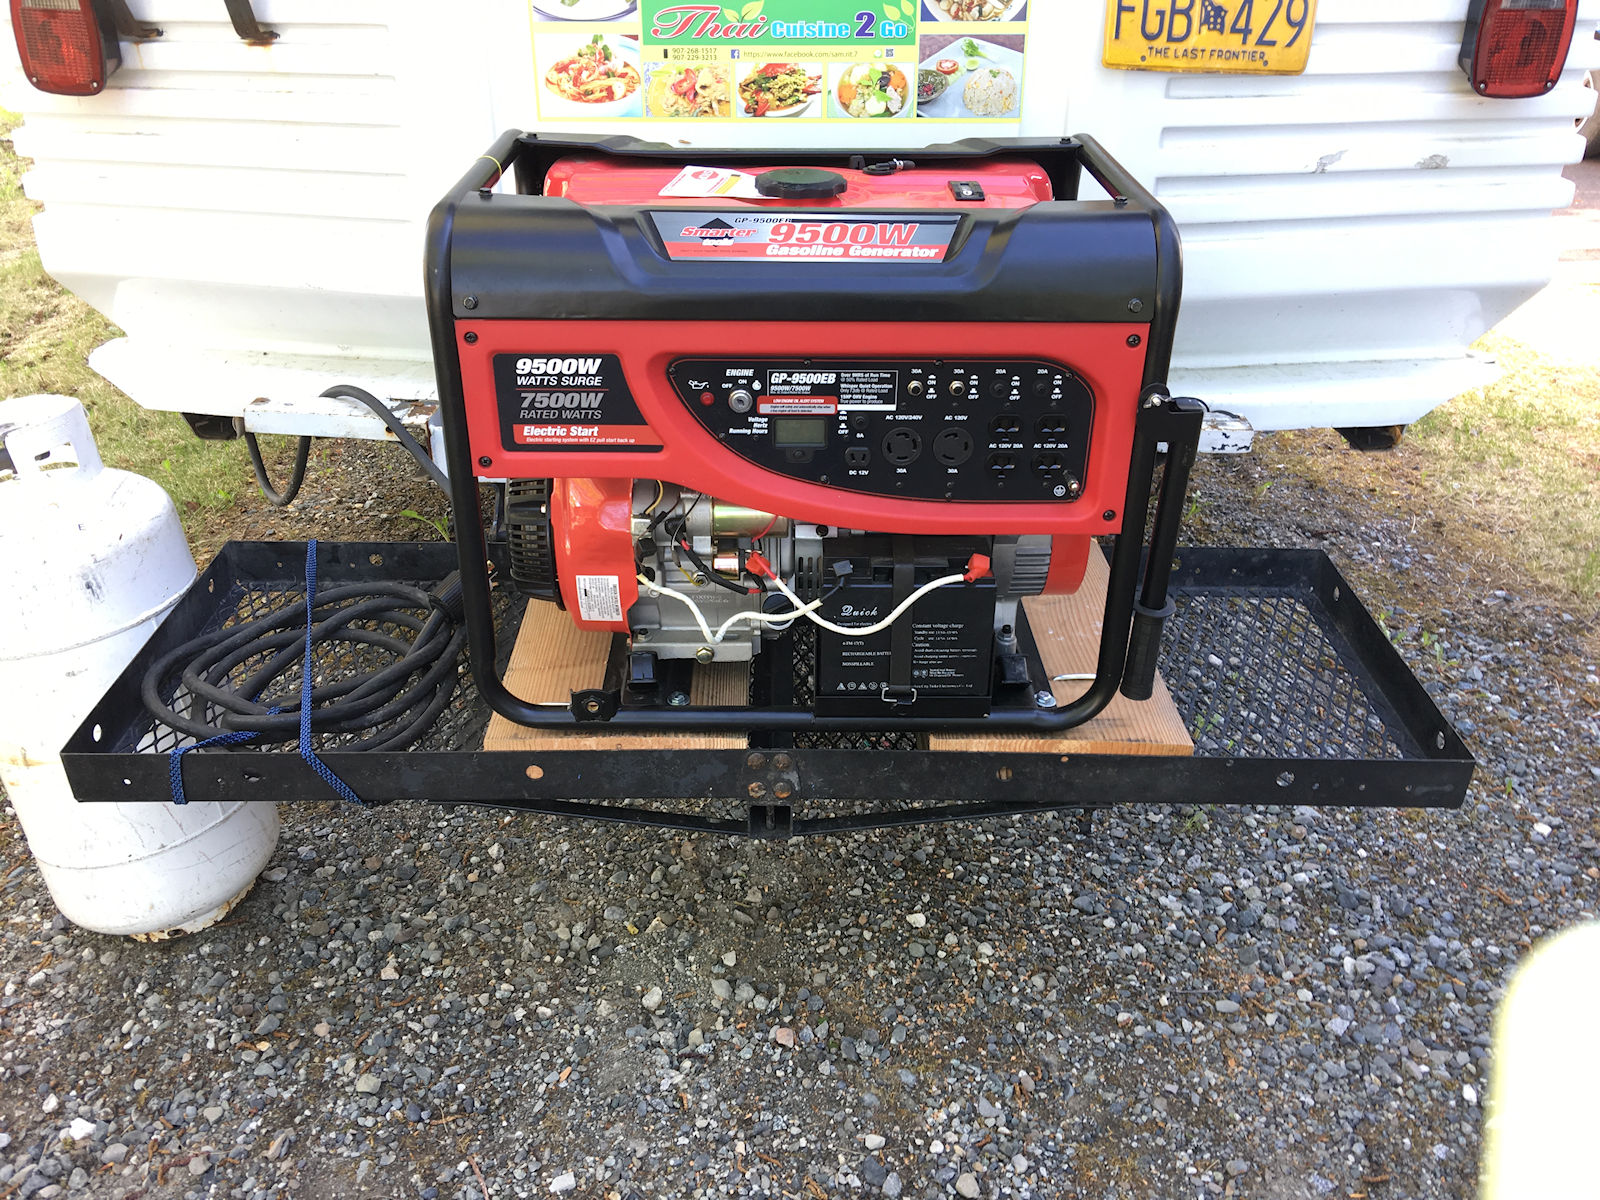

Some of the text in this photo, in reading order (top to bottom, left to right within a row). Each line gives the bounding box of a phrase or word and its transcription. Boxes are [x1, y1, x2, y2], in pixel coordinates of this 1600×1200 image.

[651, 5, 908, 39] Thai Cuisine 2 Go
[1230, 0, 1308, 48] 429
[1148, 47, 1265, 62] THE LAST FRONTIER
[680, 226, 757, 237] Smarter
[768, 223, 919, 245] 9500W
[766, 244, 939, 257] Gasoline Generator
[516, 358, 602, 375] 9500W
[726, 369, 754, 377] ENGINE
[517, 376, 602, 386] WATTS SURGE
[771, 373, 836, 384] GP-9500EB
[520, 392, 604, 408] 7500W
[520, 409, 602, 419] RATED WATTS
[523, 426, 599, 436] Electric Start
